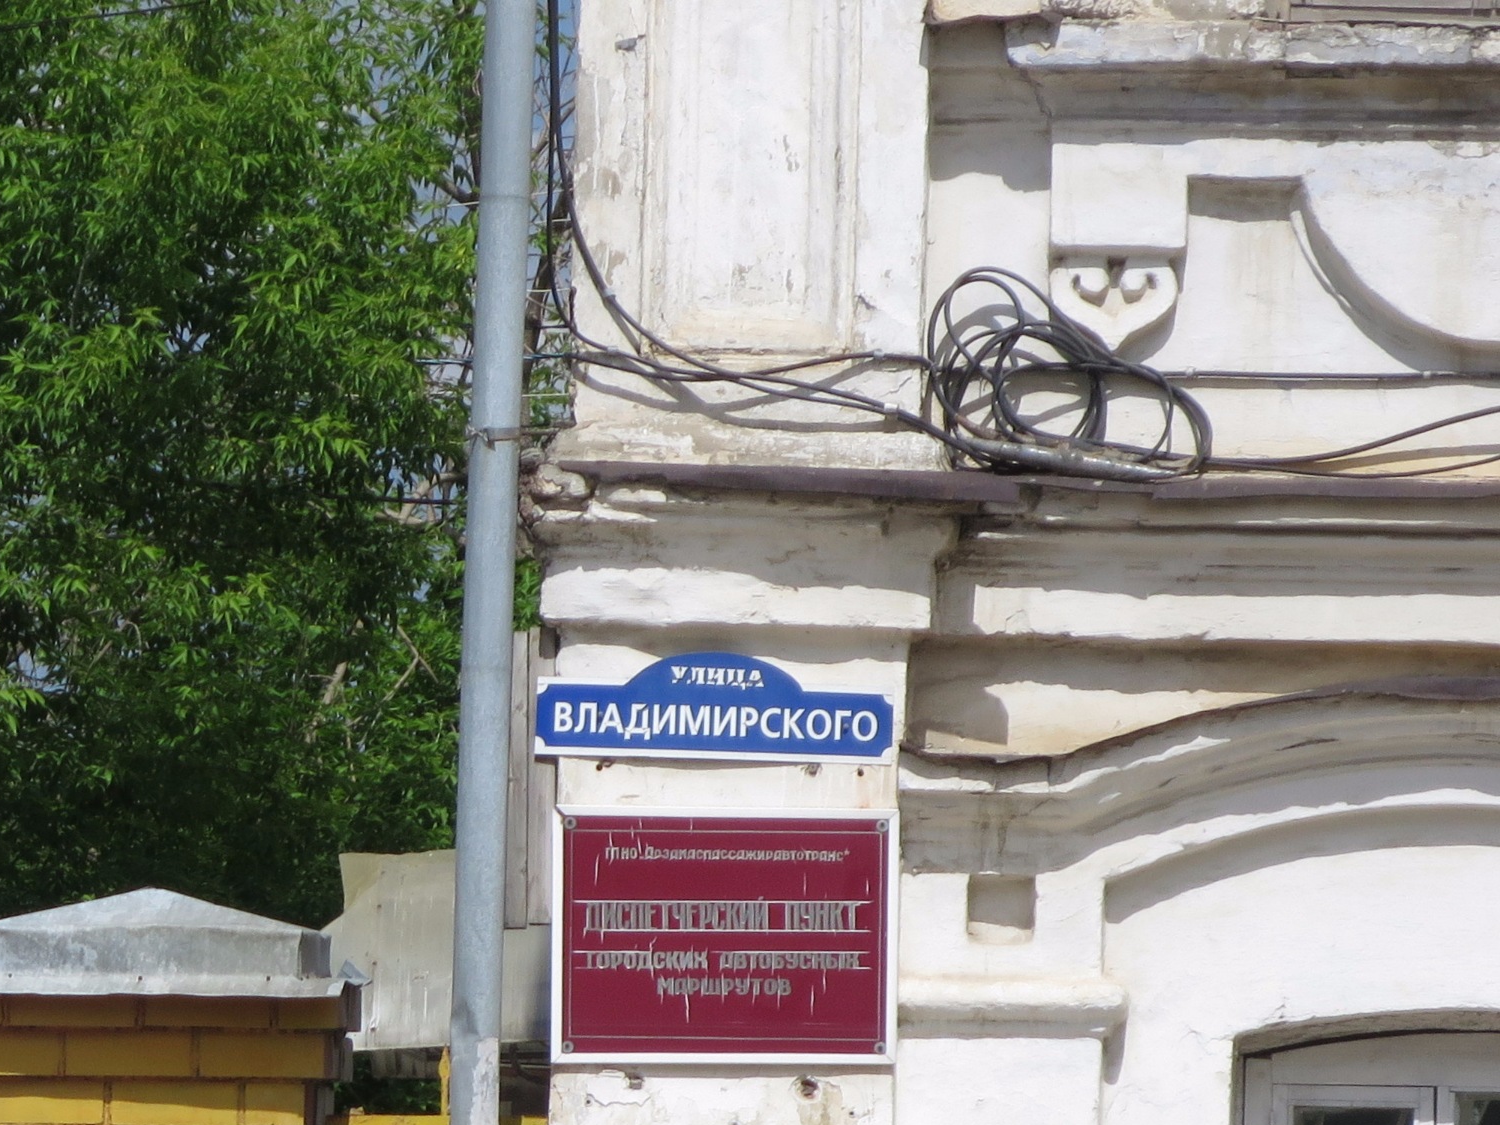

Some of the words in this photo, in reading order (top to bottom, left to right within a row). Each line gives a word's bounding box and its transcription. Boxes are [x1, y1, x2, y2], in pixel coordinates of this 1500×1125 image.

[670, 665, 765, 690] УЛИЦА
[553, 701, 879, 742] ВЛАДИМИРСКОГО
[584, 897, 768, 934] ДИСПЕТЧЕРСКИЙ
[785, 901, 860, 932] ПУНКТ
[586, 951, 708, 970] ГОРОДСКИХ
[719, 951, 860, 971] АВТОБУСНЫХ
[657, 976, 792, 996] МАРШРУТОВ
